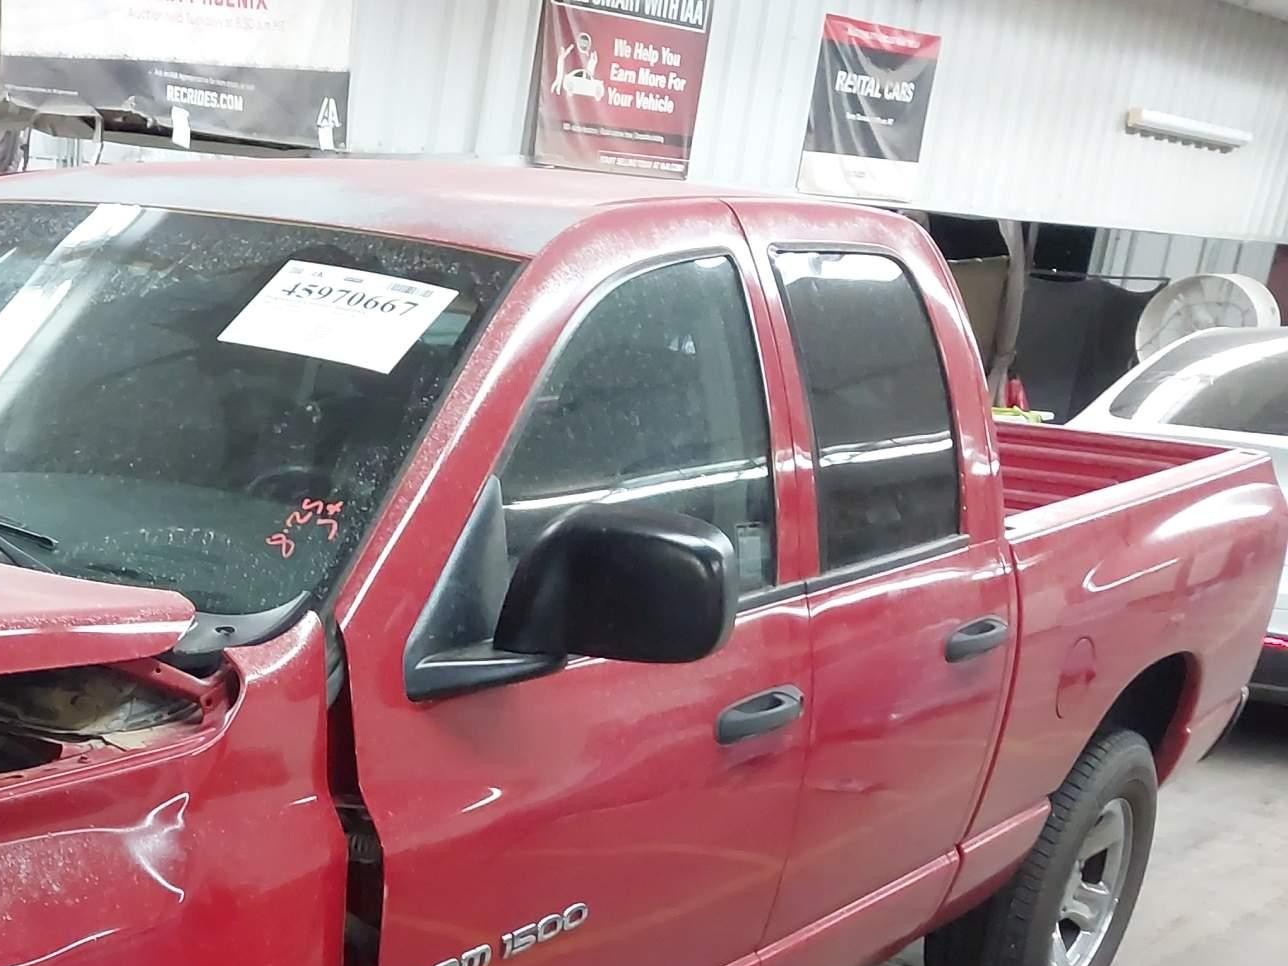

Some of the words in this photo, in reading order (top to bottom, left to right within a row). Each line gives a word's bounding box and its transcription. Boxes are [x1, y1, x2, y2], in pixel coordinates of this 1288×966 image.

[614, 38, 631, 58] We
[633, 41, 659, 68] Help
[661, 46, 681, 67] You
[609, 62, 636, 84] Earn
[637, 67, 667, 89] More
[667, 72, 687, 92] For
[835, 70, 882, 99] RENTAL
[883, 79, 916, 103] CARS
[166, 84, 244, 111] RECRIDES.COM
[607, 86, 633, 108] Your
[635, 90, 674, 114] Vehicle
[281, 281, 420, 317] 45970667
[500, 902, 589, 960] 1500
